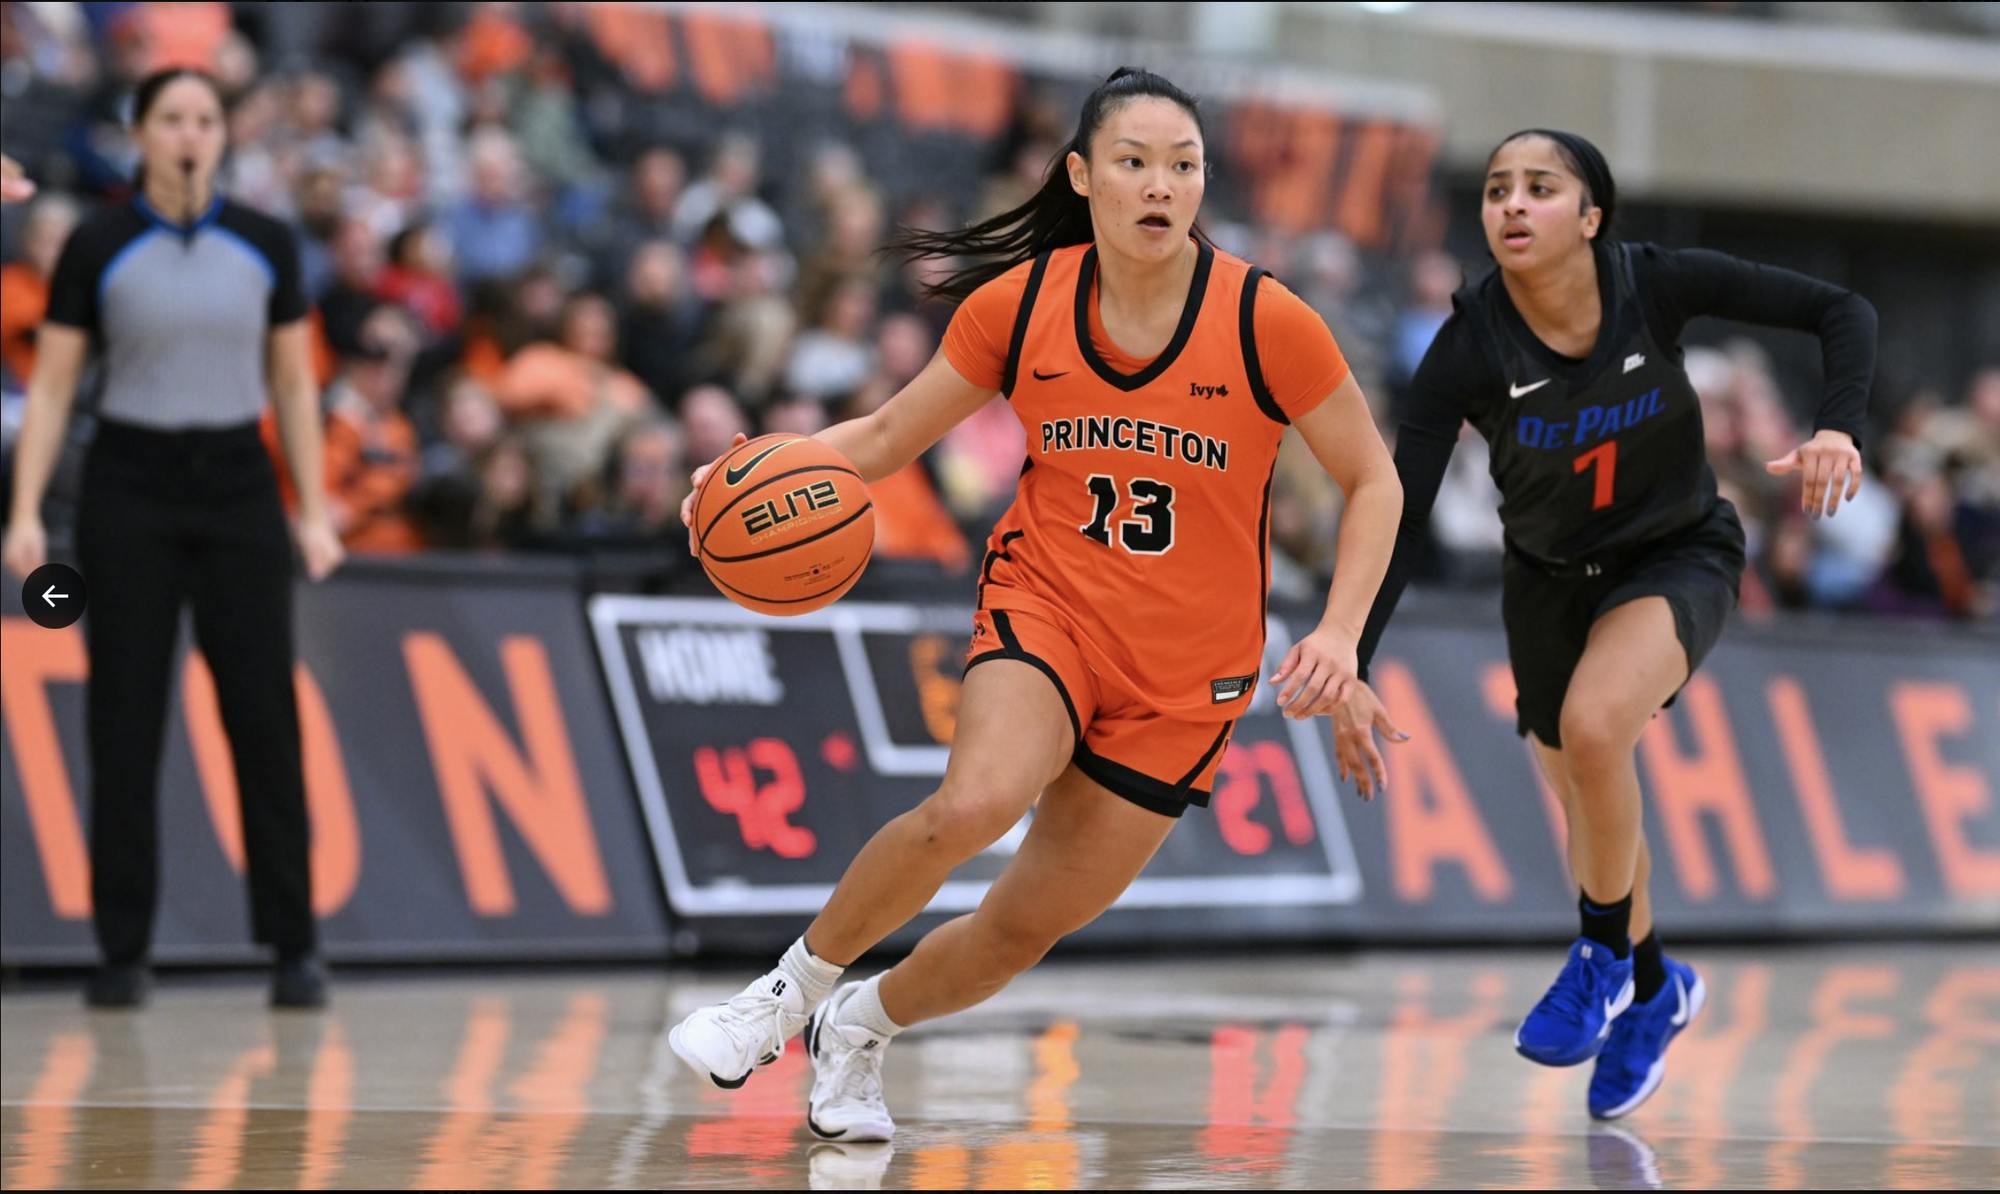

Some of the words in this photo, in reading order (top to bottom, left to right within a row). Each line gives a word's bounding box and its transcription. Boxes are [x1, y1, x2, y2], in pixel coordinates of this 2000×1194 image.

[1190, 382, 1215, 400] Ivy
[1041, 415, 1229, 472] PRINCETON
[1572, 439, 1618, 511] 7
[741, 479, 841, 536] ELITE
[1079, 473, 1176, 556] 13
[693, 737, 817, 859] 42
[1214, 739, 1316, 856] 27
